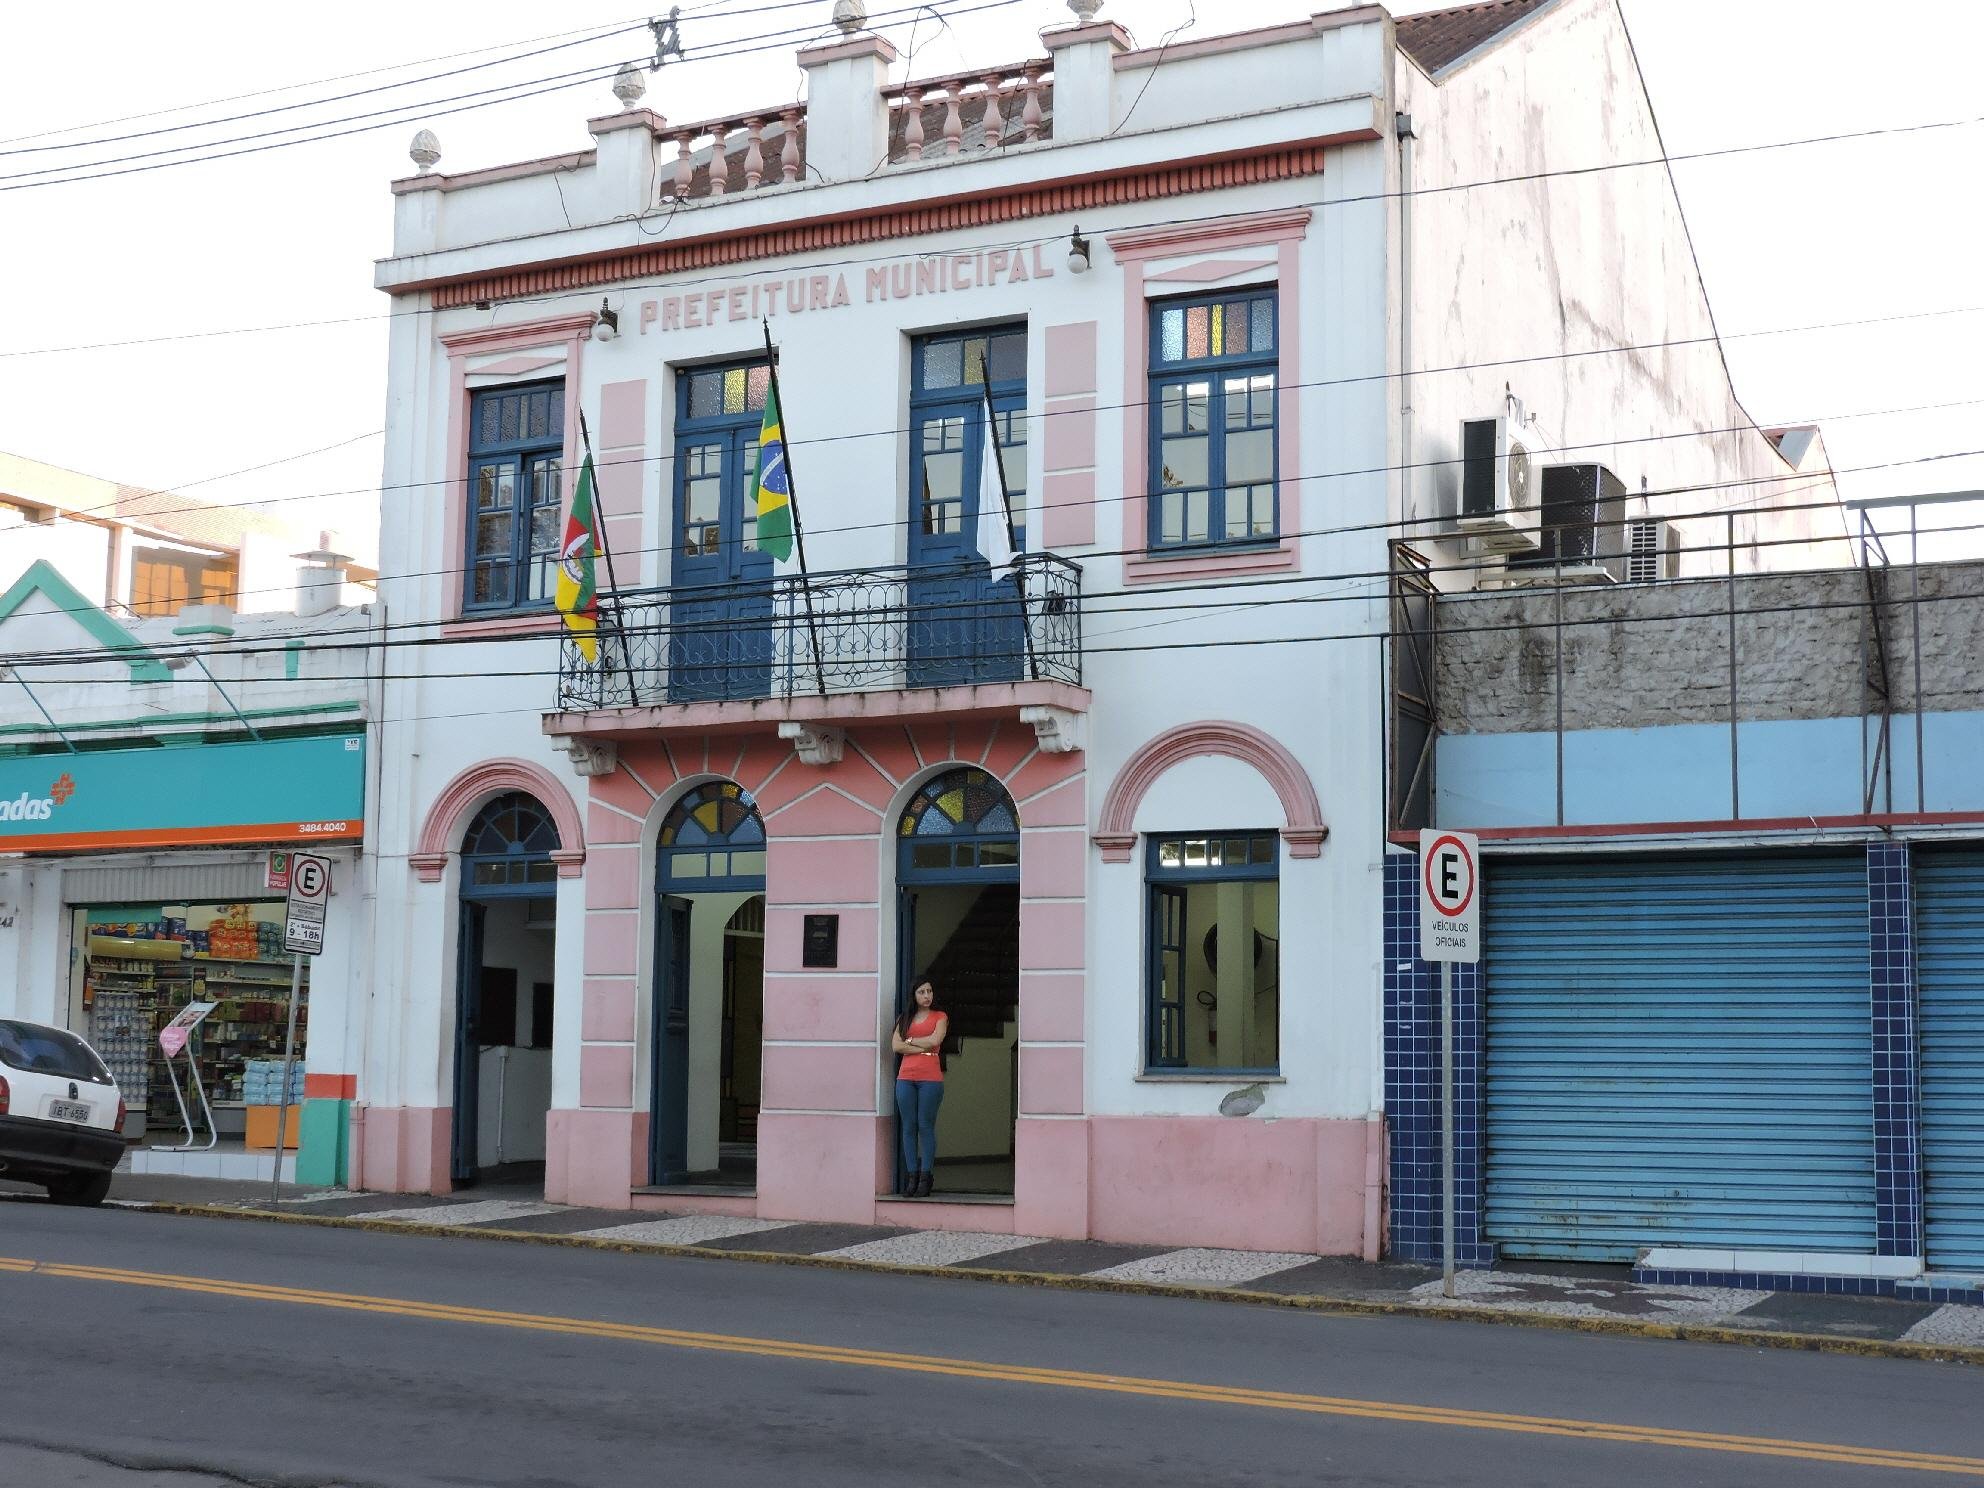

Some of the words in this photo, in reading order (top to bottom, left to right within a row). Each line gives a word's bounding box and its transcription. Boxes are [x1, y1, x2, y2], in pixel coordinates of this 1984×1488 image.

[639, 273, 850, 335] PREFEITURA
[865, 244, 1055, 303] MUNICIPAL
[298, 822, 347, 833] 3484.4040
[304, 868, 316, 890] E
[1442, 853, 1458, 899] E
[1431, 919, 1469, 933] VEÍCULOS
[289, 928, 296, 937] 9
[303, 930, 320, 941] 18h
[1435, 936, 1467, 948] OFICIAIS
